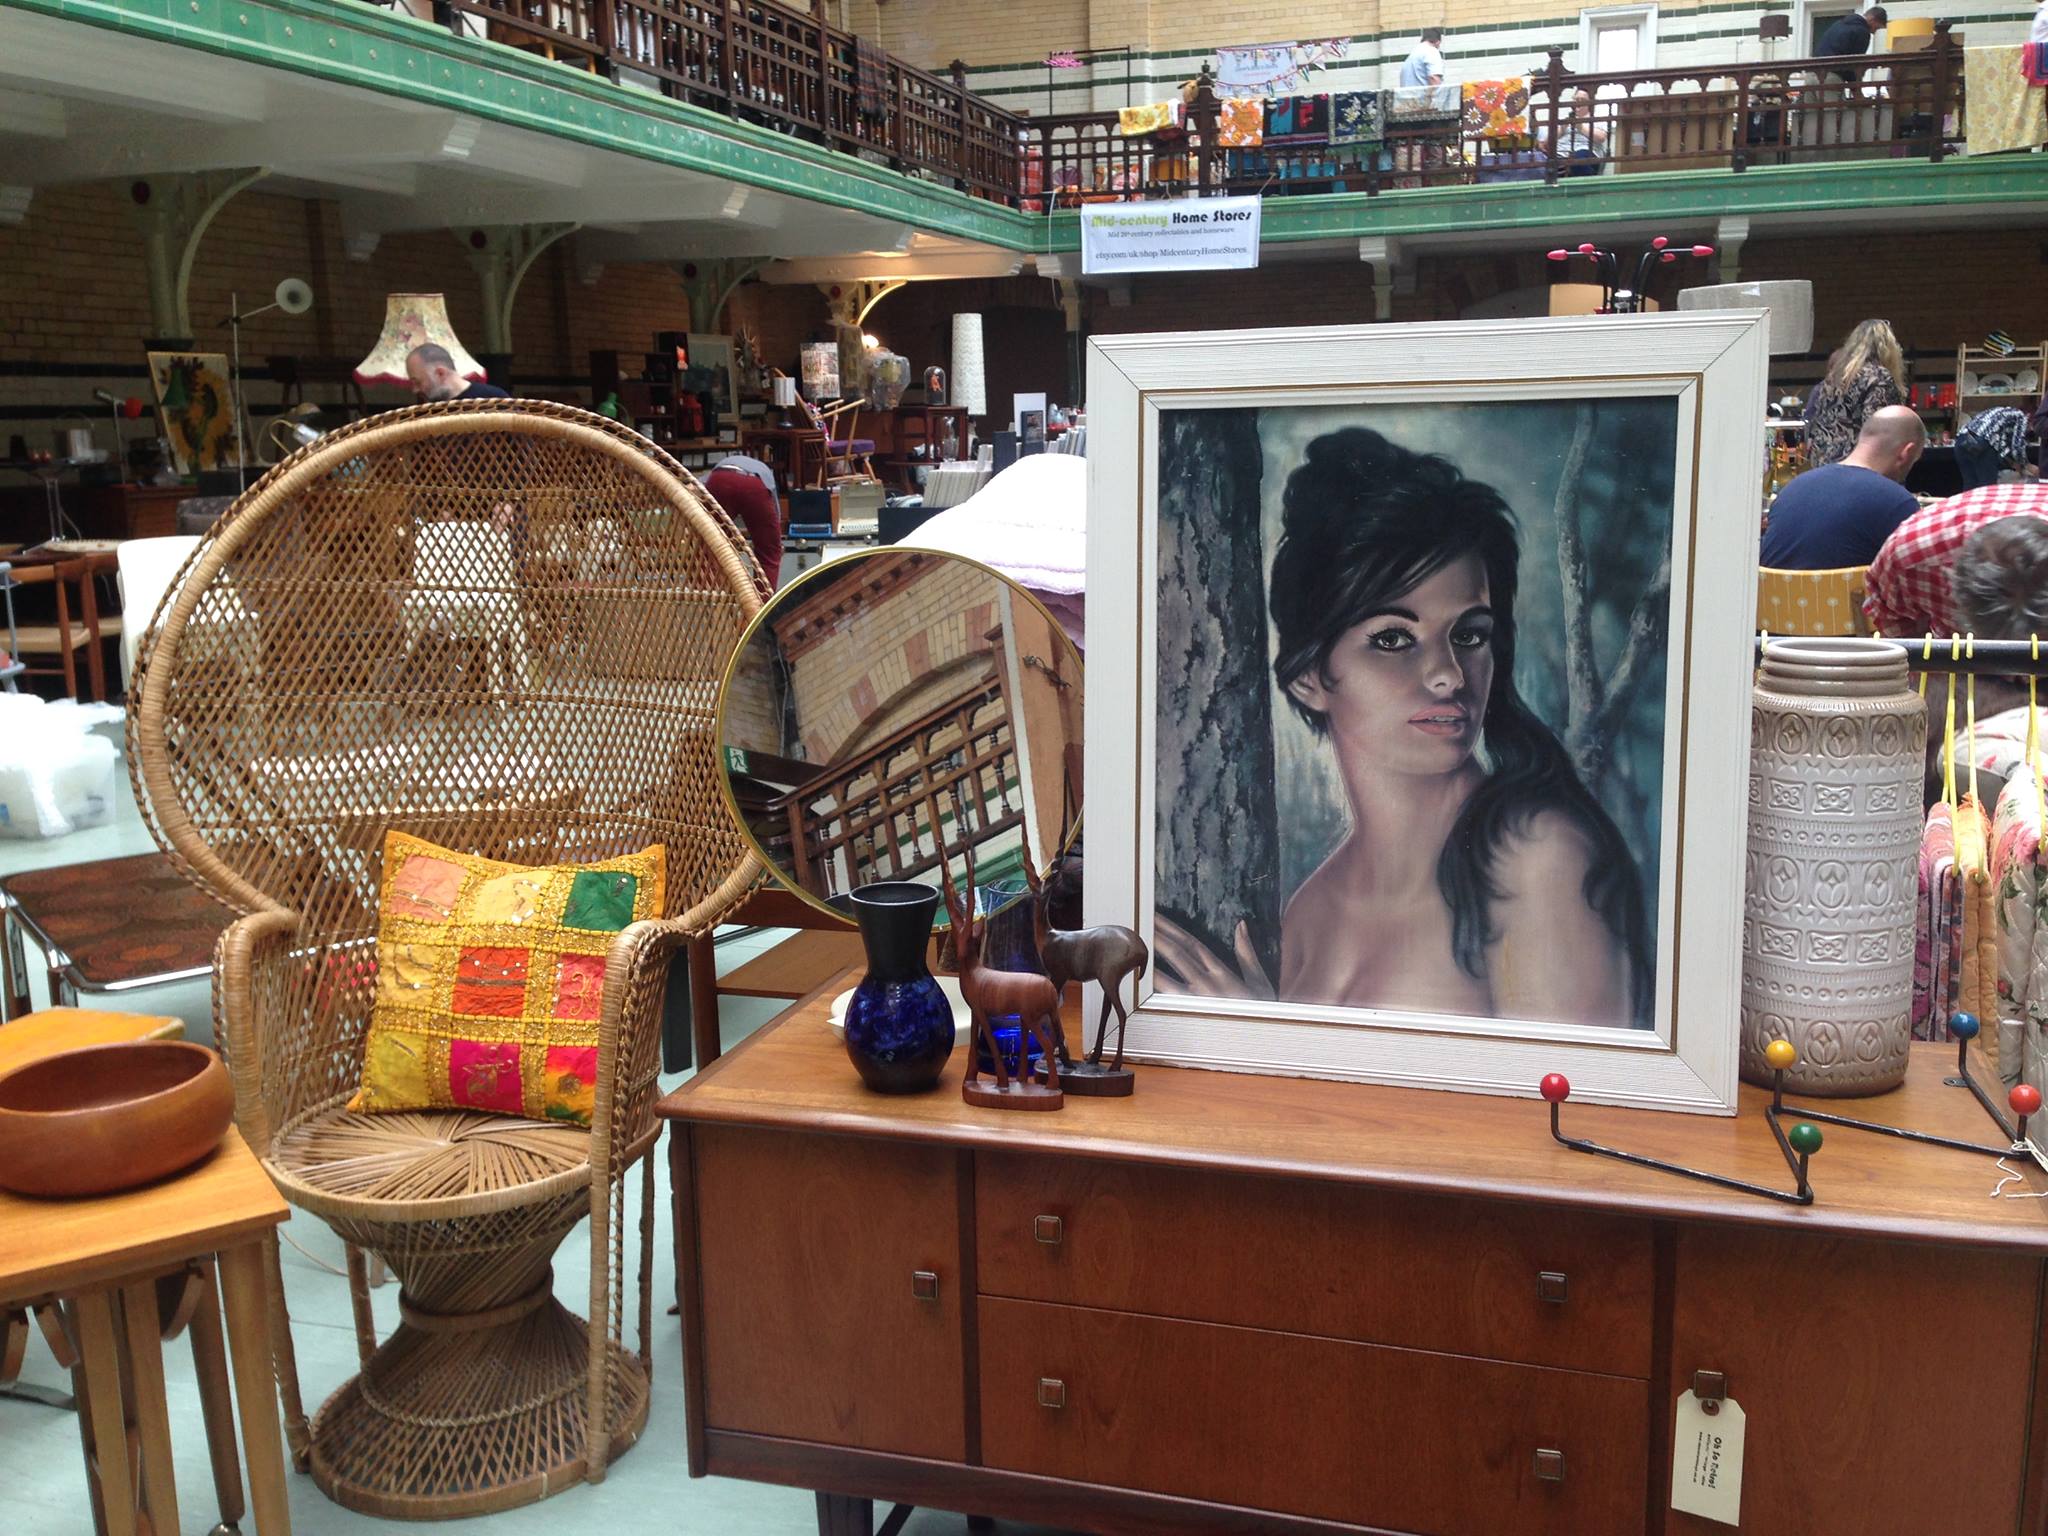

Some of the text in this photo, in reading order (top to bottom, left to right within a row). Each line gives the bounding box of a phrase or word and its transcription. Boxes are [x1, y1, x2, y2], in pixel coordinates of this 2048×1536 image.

[1091, 210, 1252, 227] Mid-century Home Stores
[1190, 227, 1202, 235] and
[1713, 1437, 1722, 1449] Oh
